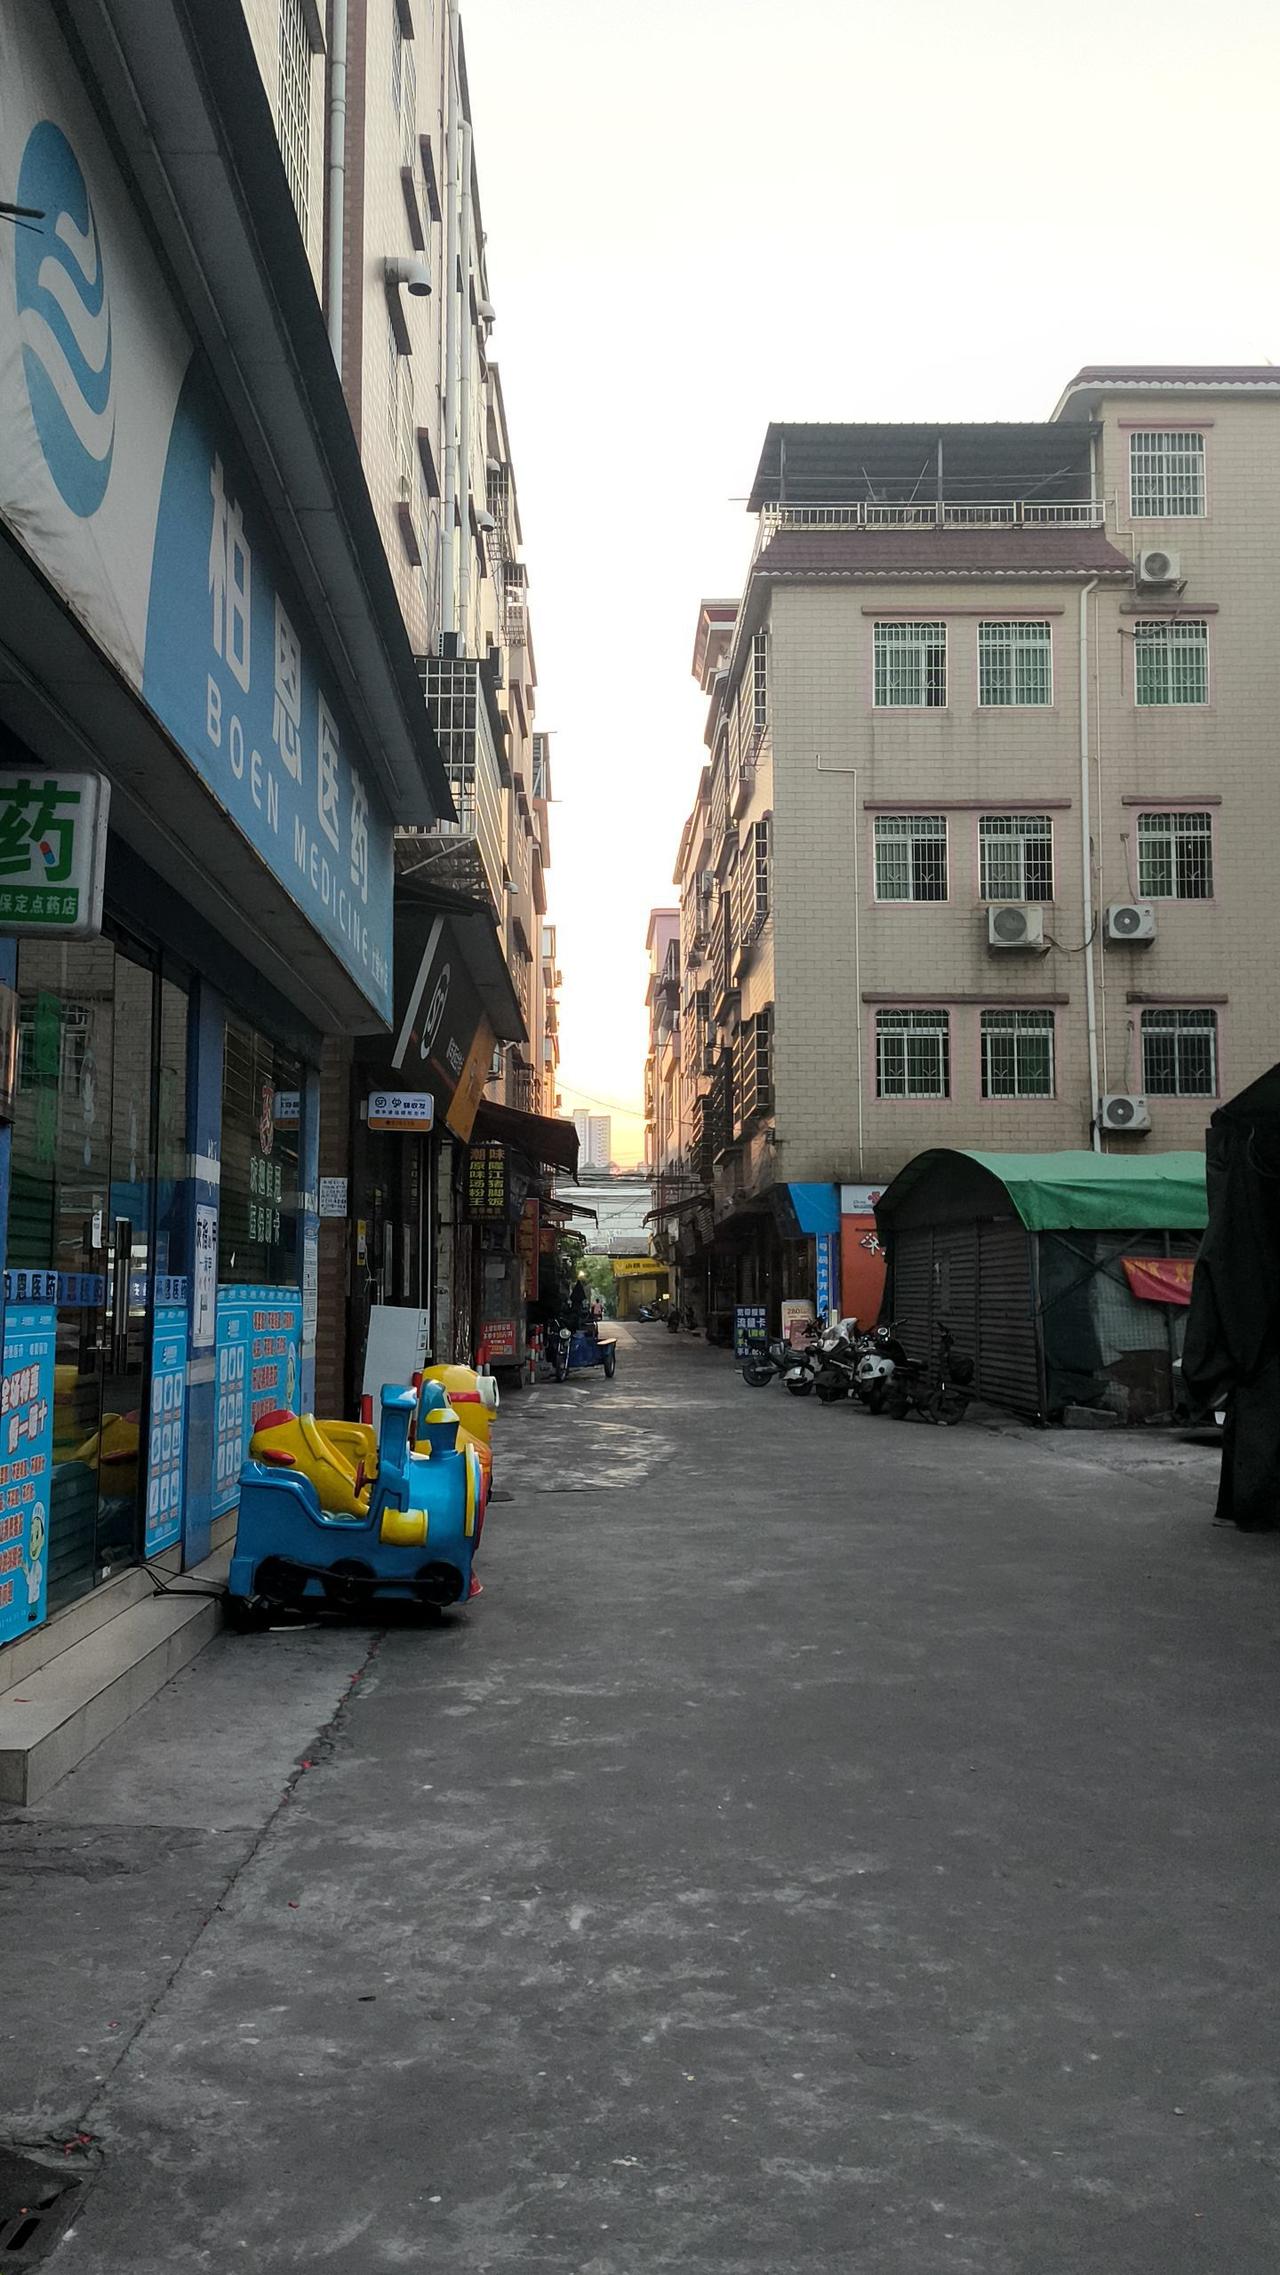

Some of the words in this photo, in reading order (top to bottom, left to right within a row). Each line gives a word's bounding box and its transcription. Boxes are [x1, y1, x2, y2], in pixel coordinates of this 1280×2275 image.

[209, 453, 369, 904] 柏恩医药
[0, 779, 80, 882] 药
[0, 895, 77, 915] 保定点药店
[206, 672, 280, 834] BOEN
[294, 814, 369, 964] MEDICINE
